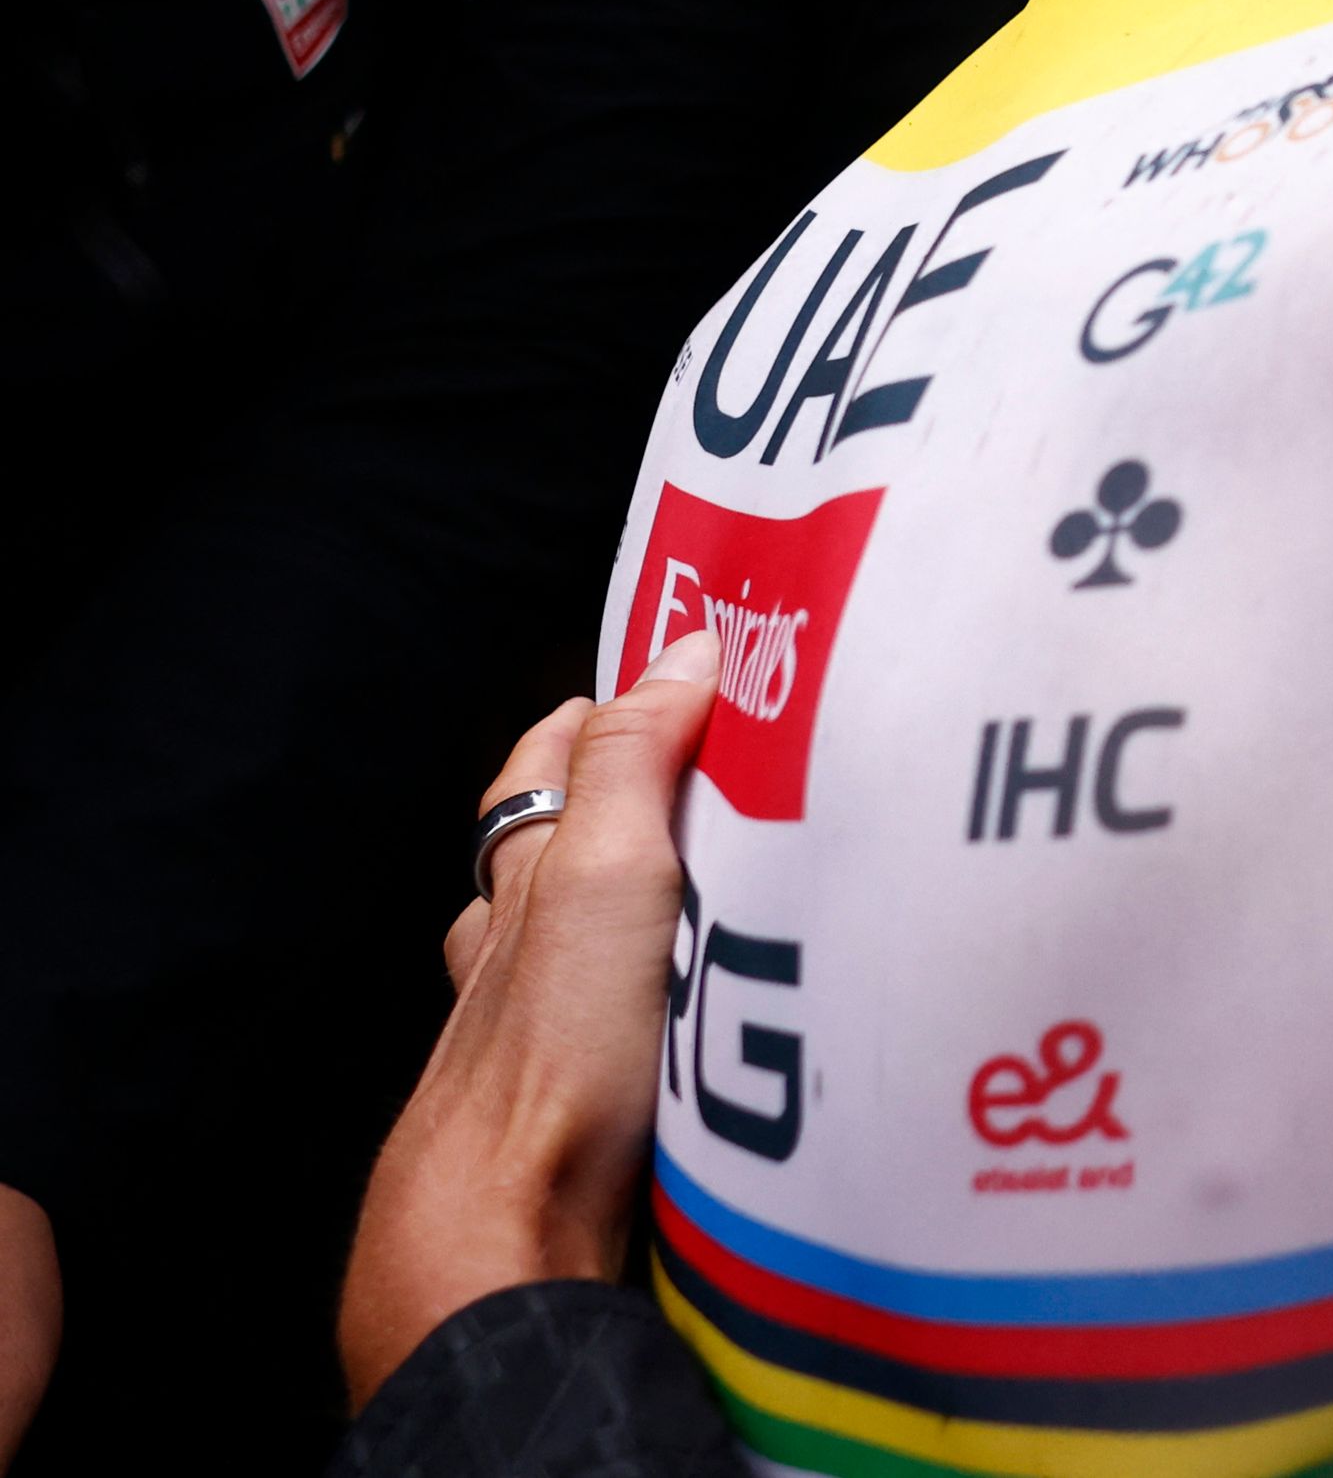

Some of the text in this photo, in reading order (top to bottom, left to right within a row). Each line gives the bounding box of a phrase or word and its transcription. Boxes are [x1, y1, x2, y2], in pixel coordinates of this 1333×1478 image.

[693, 147, 1072, 466] UAE
[1079, 228, 1270, 365] G42
[648, 556, 809, 723] Emirates
[966, 704, 1187, 844] IHC
